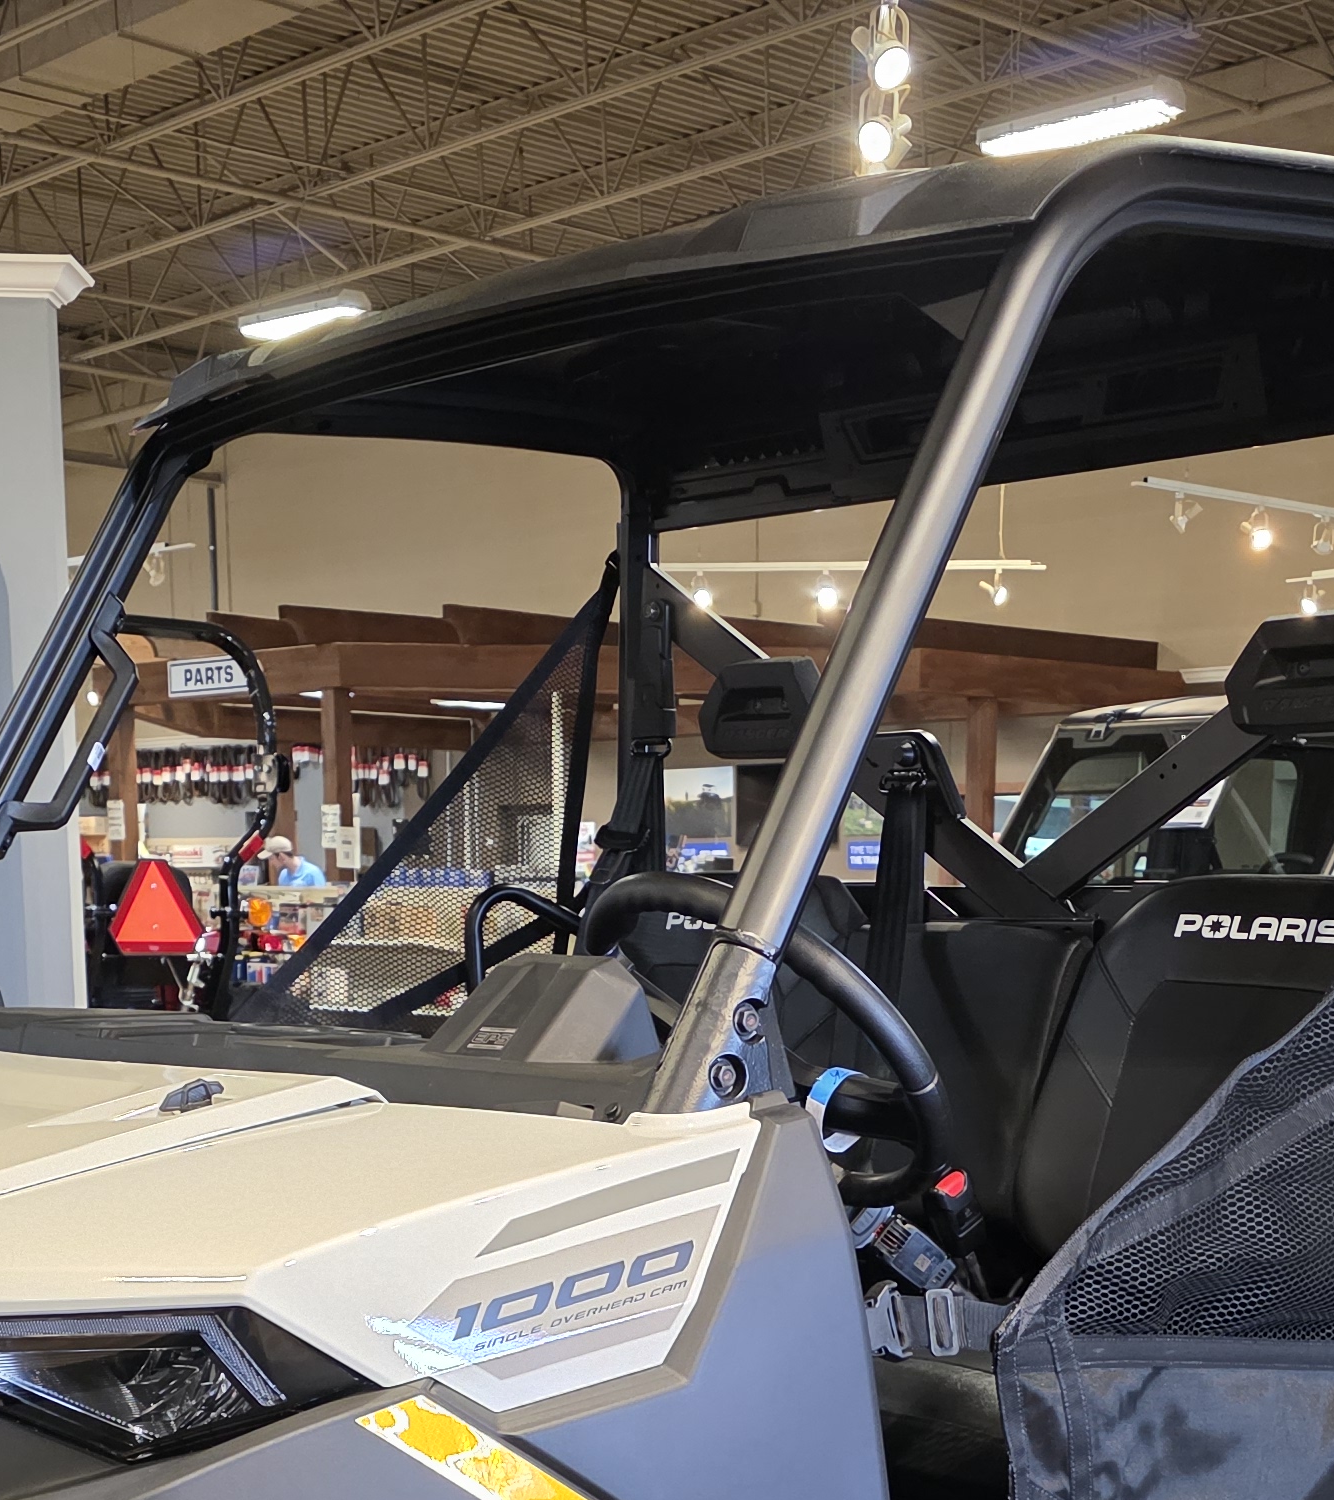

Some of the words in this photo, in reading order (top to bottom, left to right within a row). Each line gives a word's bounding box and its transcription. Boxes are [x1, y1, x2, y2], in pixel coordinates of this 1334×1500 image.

[184, 665, 234, 687] PARTS
[451, 1239, 696, 1342] 1000
[474, 1323, 544, 1352] SINGLE
[550, 1291, 646, 1328] OVERHEAD
[650, 1279, 688, 1299] CAM
